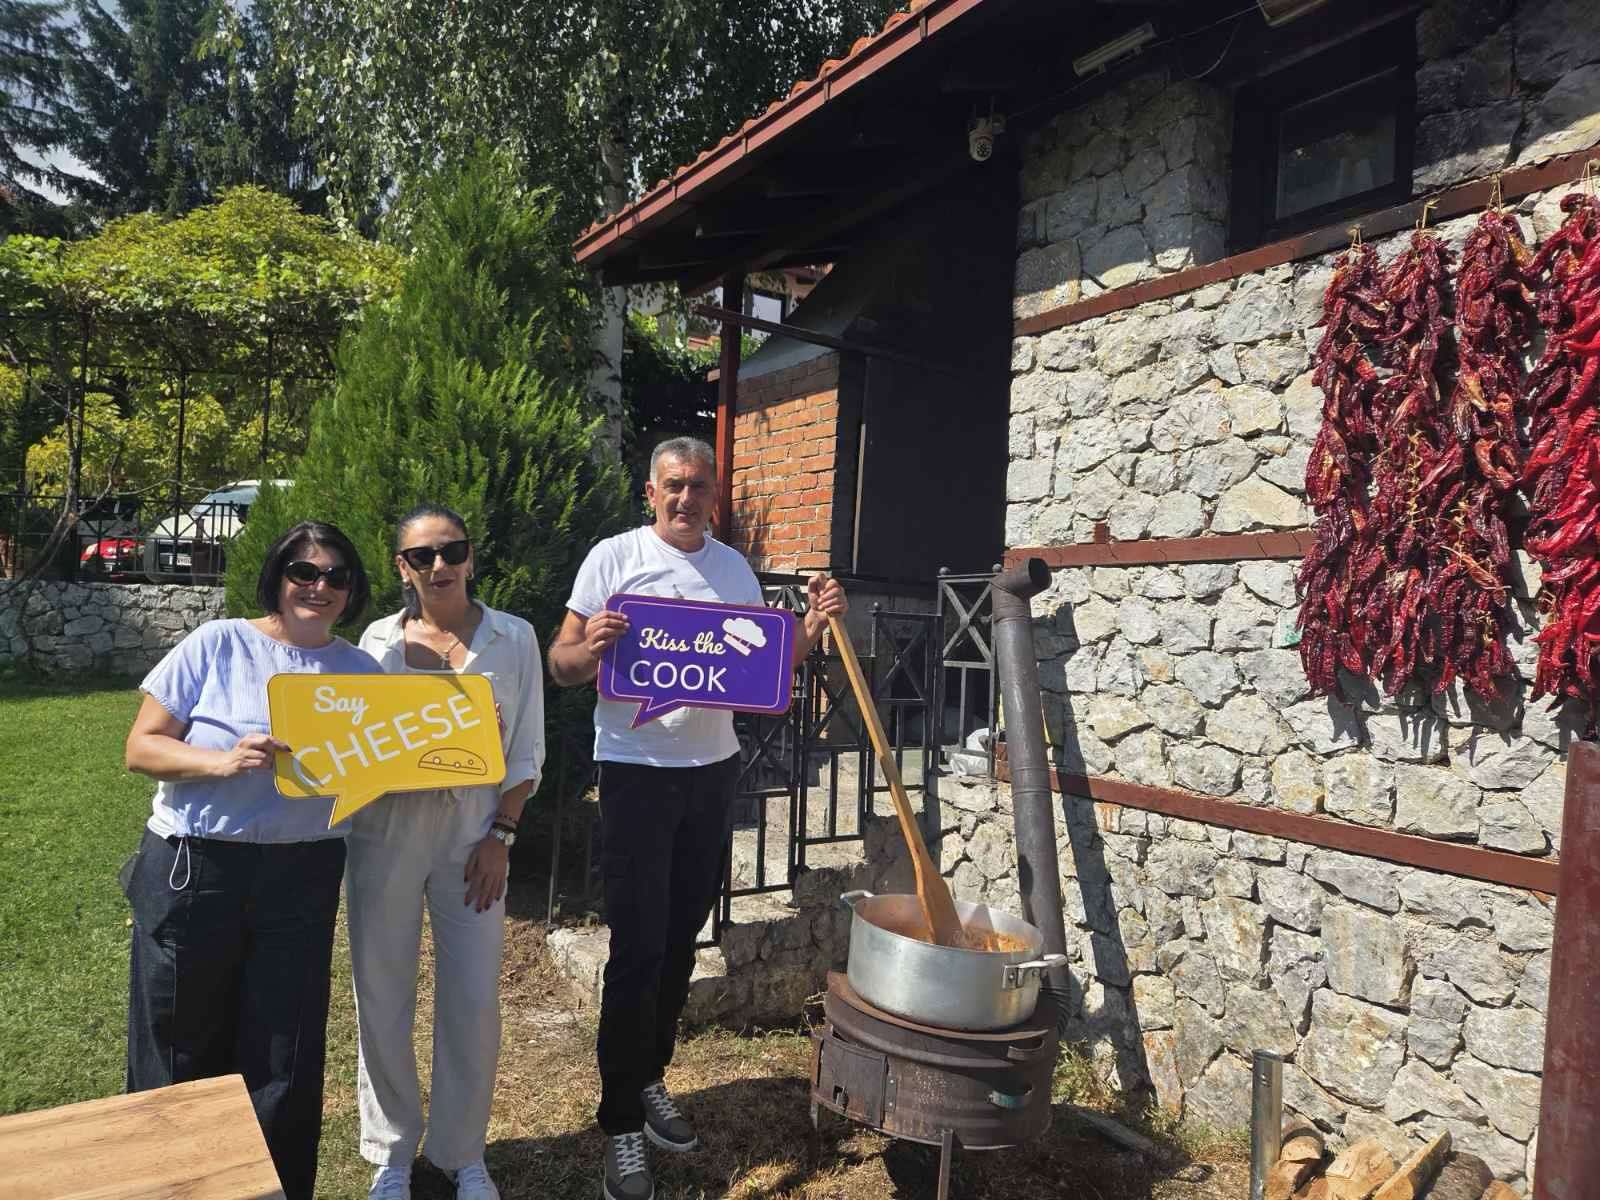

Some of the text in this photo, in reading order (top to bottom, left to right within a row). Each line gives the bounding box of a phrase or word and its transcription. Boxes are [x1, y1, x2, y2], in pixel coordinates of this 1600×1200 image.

[639, 627, 726, 655] Kiss the
[629, 660, 727, 693] COOK
[313, 685, 370, 724] Say
[292, 694, 481, 786] CHEESE
